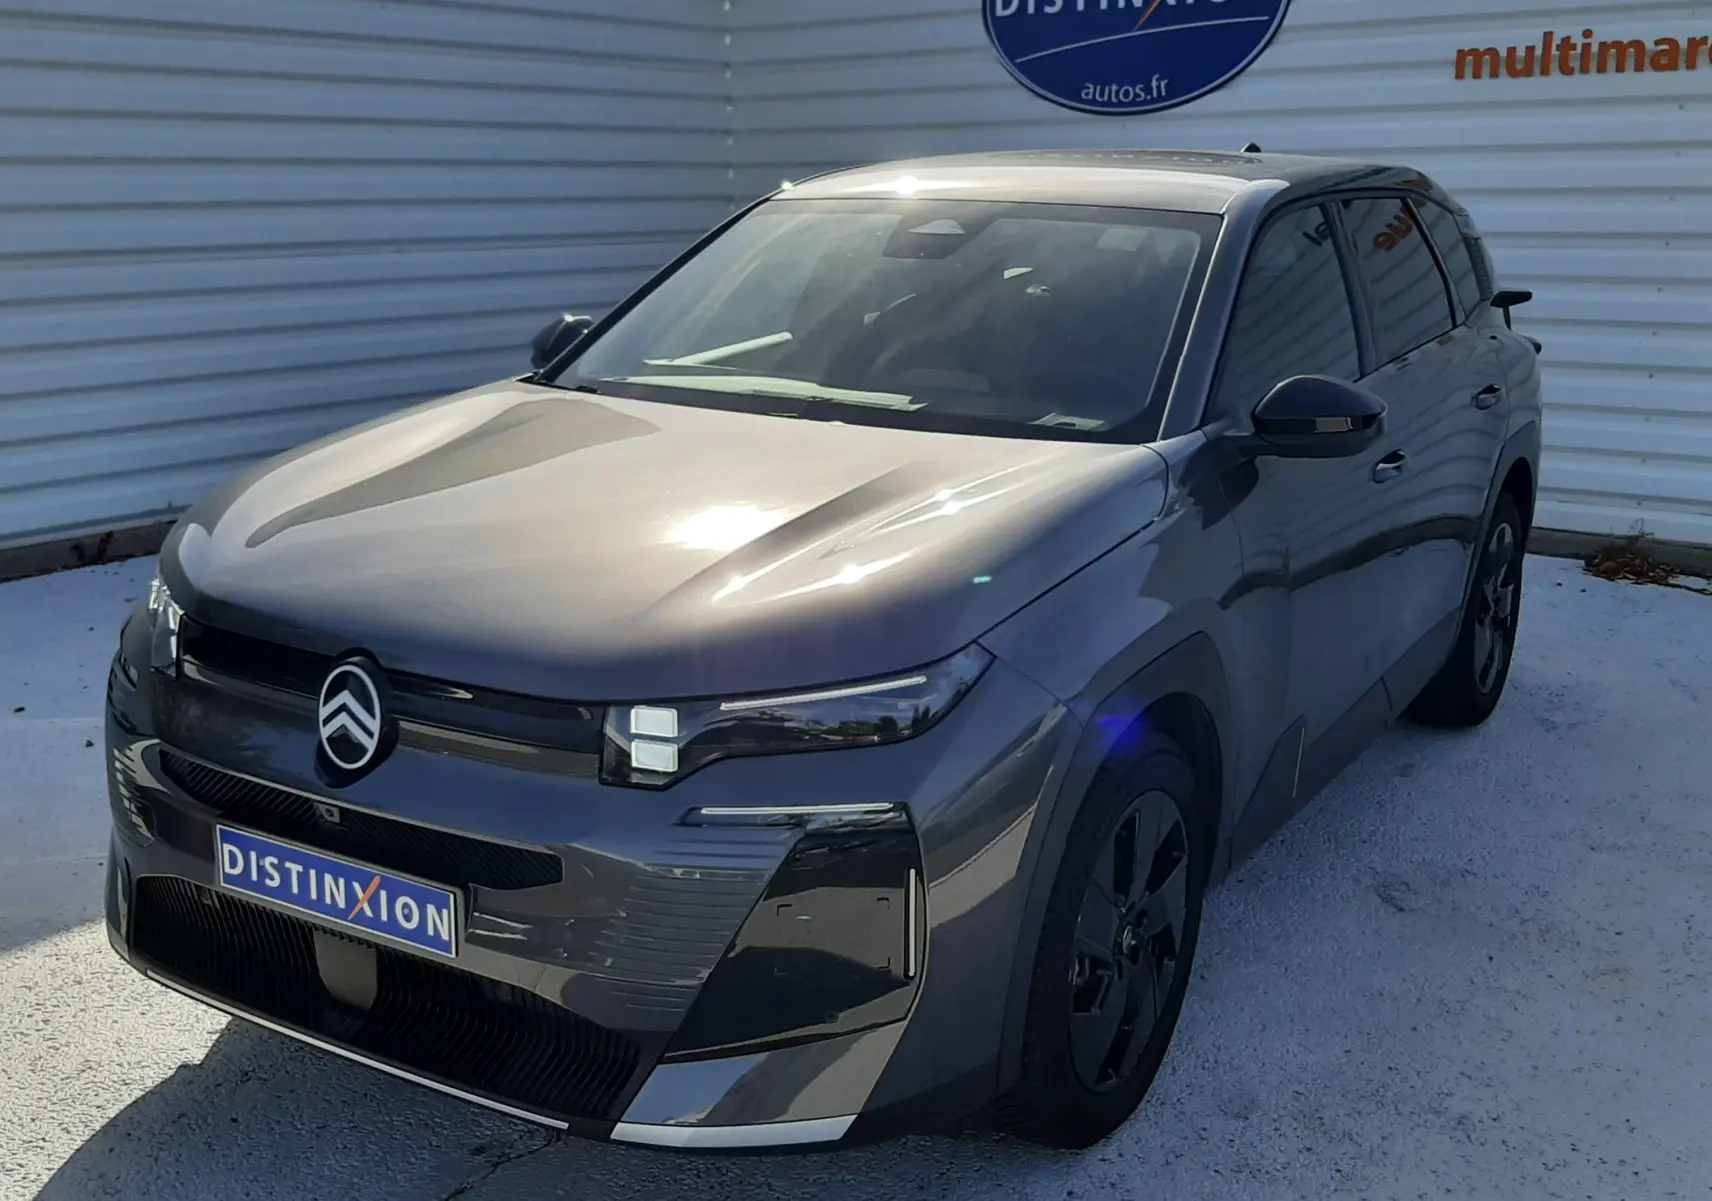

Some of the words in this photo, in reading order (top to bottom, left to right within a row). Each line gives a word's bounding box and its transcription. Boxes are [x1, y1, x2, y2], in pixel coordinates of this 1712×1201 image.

[1454, 28, 1712, 80] multimar
[1080, 73, 1169, 103] autos.fr
[222, 842, 450, 942] DISTINXION
